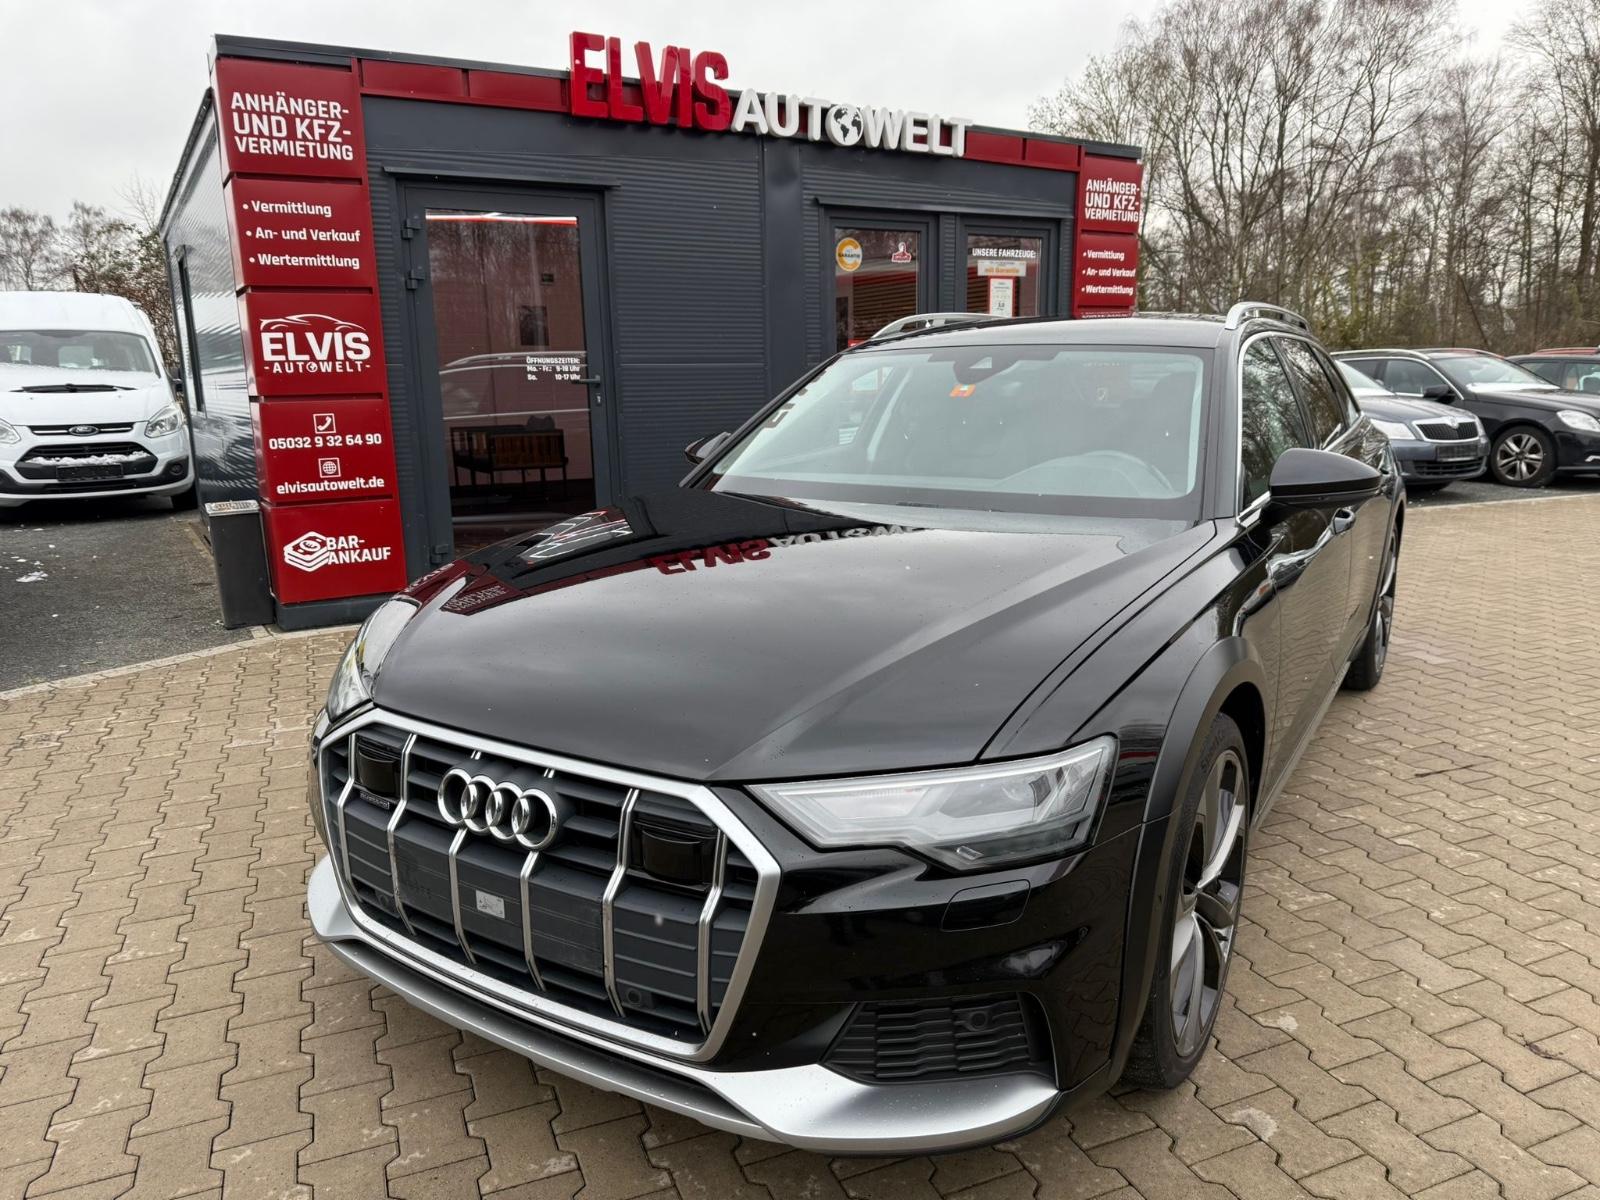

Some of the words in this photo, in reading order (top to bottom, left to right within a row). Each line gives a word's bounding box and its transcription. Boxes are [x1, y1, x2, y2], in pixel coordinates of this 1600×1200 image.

[569, 30, 731, 131] ELVIS
[731, 88, 973, 157] AUTOWELT
[231, 91, 349, 119] ANHÄNGER-
[232, 112, 287, 136] UND
[295, 118, 351, 142] KFZ-
[234, 136, 353, 160] VERMIETUNG
[1086, 178, 1140, 195] ANHÄNGER-
[251, 200, 332, 218] Vermittlung
[1086, 192, 1110, 207] UND
[1113, 195, 1139, 211] KFZ-
[1085, 208, 1139, 222] VERMIETUNG
[255, 227, 278, 239] An-
[281, 229, 307, 241] und
[310, 229, 360, 243] Verkauf
[972, 248, 998, 257] UNSERE
[1087, 250, 1124, 261] Vermittlung
[258, 253, 360, 270] Wertermittlung
[1099, 267, 1112, 277] und
[1112, 268, 1135, 277] Verkauf
[1085, 285, 1133, 296] Wertermittlung
[261, 332, 371, 362] ELVIS
[526, 356, 580, 364] ÖFFNUNGSZEITEN:
[269, 436, 312, 450] 05032
[315, 436, 323, 448] 9
[328, 435, 342, 447] 32
[345, 434, 363, 446] 64
[366, 433, 382, 445] 90
[277, 476, 385, 495] elvisautowelt.de
[326, 535, 365, 551] BAR-
[327, 547, 392, 565] ANKAUF
